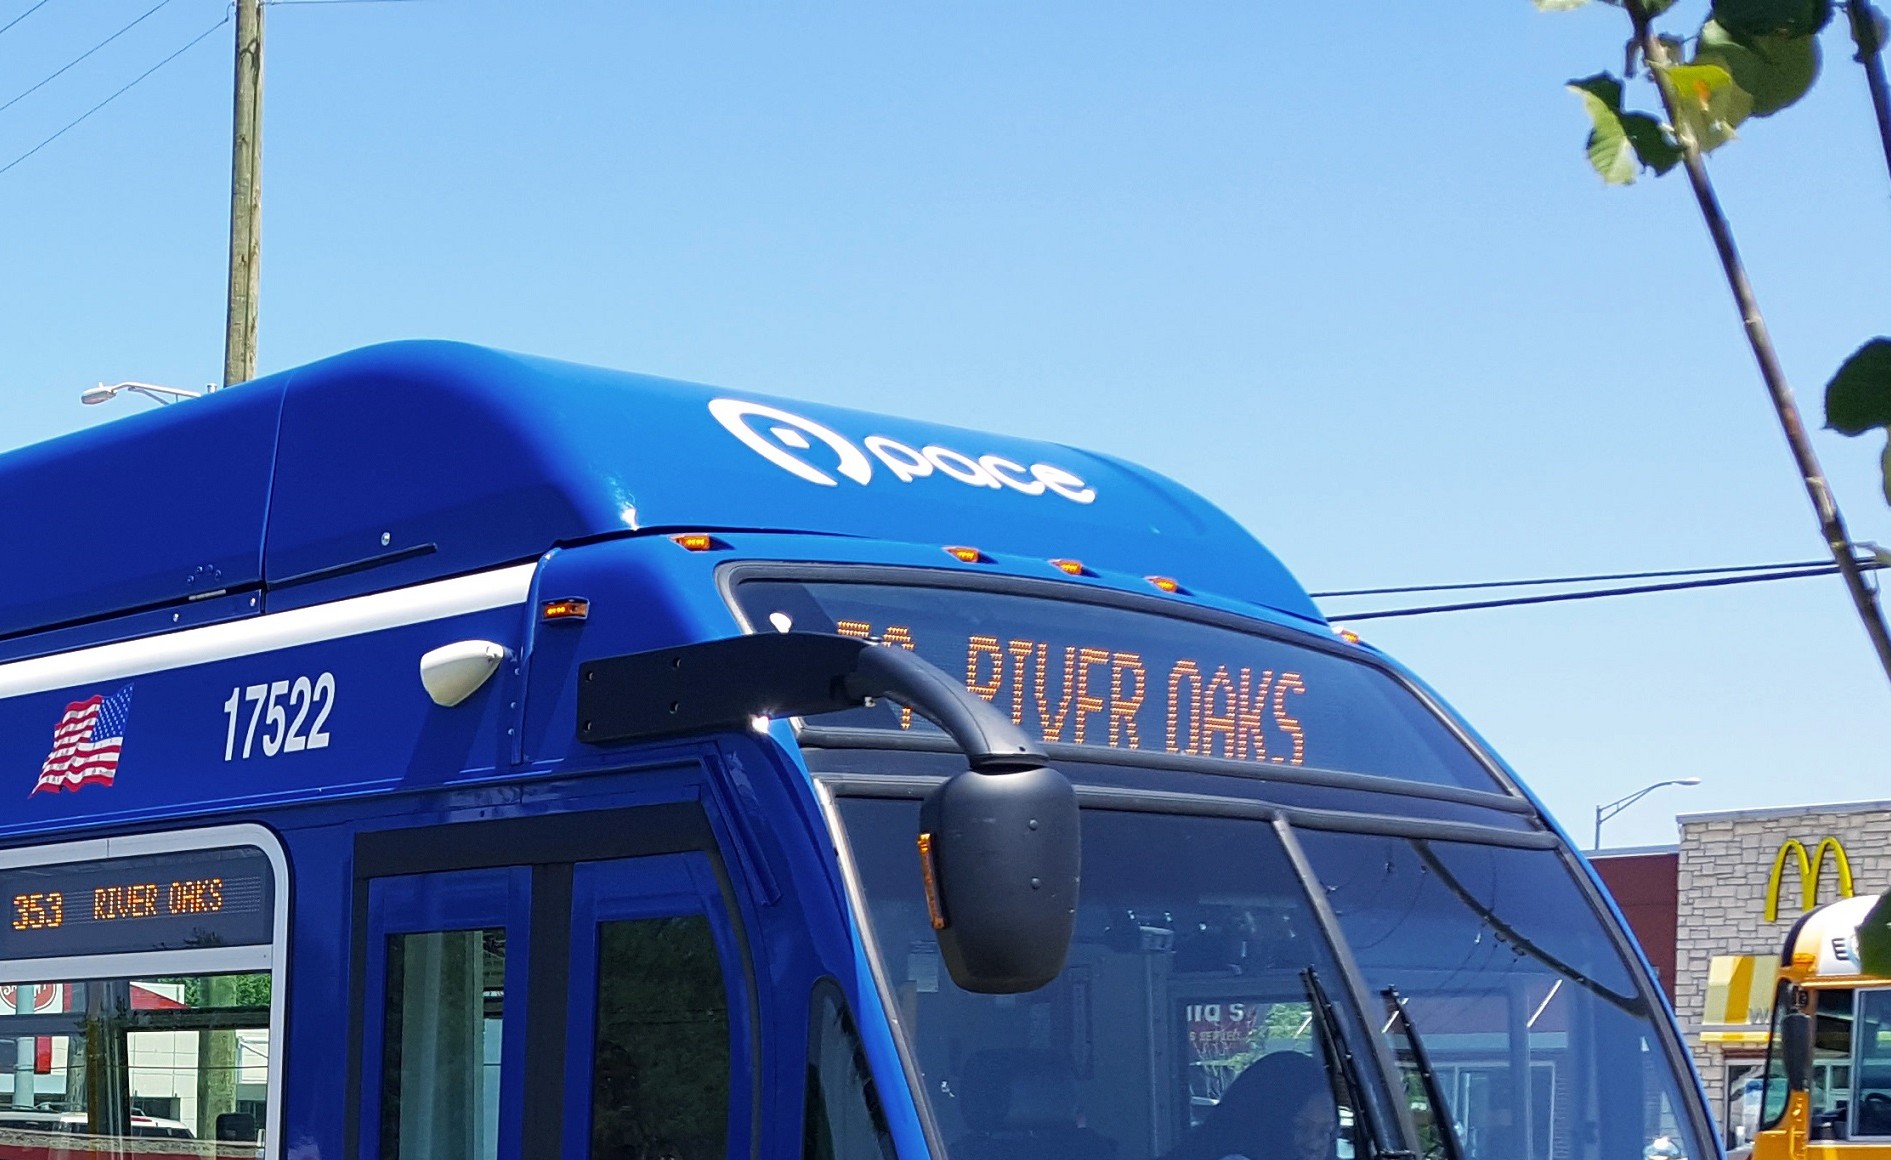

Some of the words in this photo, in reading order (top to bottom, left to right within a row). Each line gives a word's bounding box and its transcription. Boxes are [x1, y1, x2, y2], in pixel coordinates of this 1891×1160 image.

[864, 436, 1096, 504] pace
[224, 672, 336, 761] 17522
[1165, 660, 1306, 766] OAKS
[12, 893, 63, 931] 353
[94, 883, 157, 920] RIVER
[169, 878, 223, 914] OAKS
